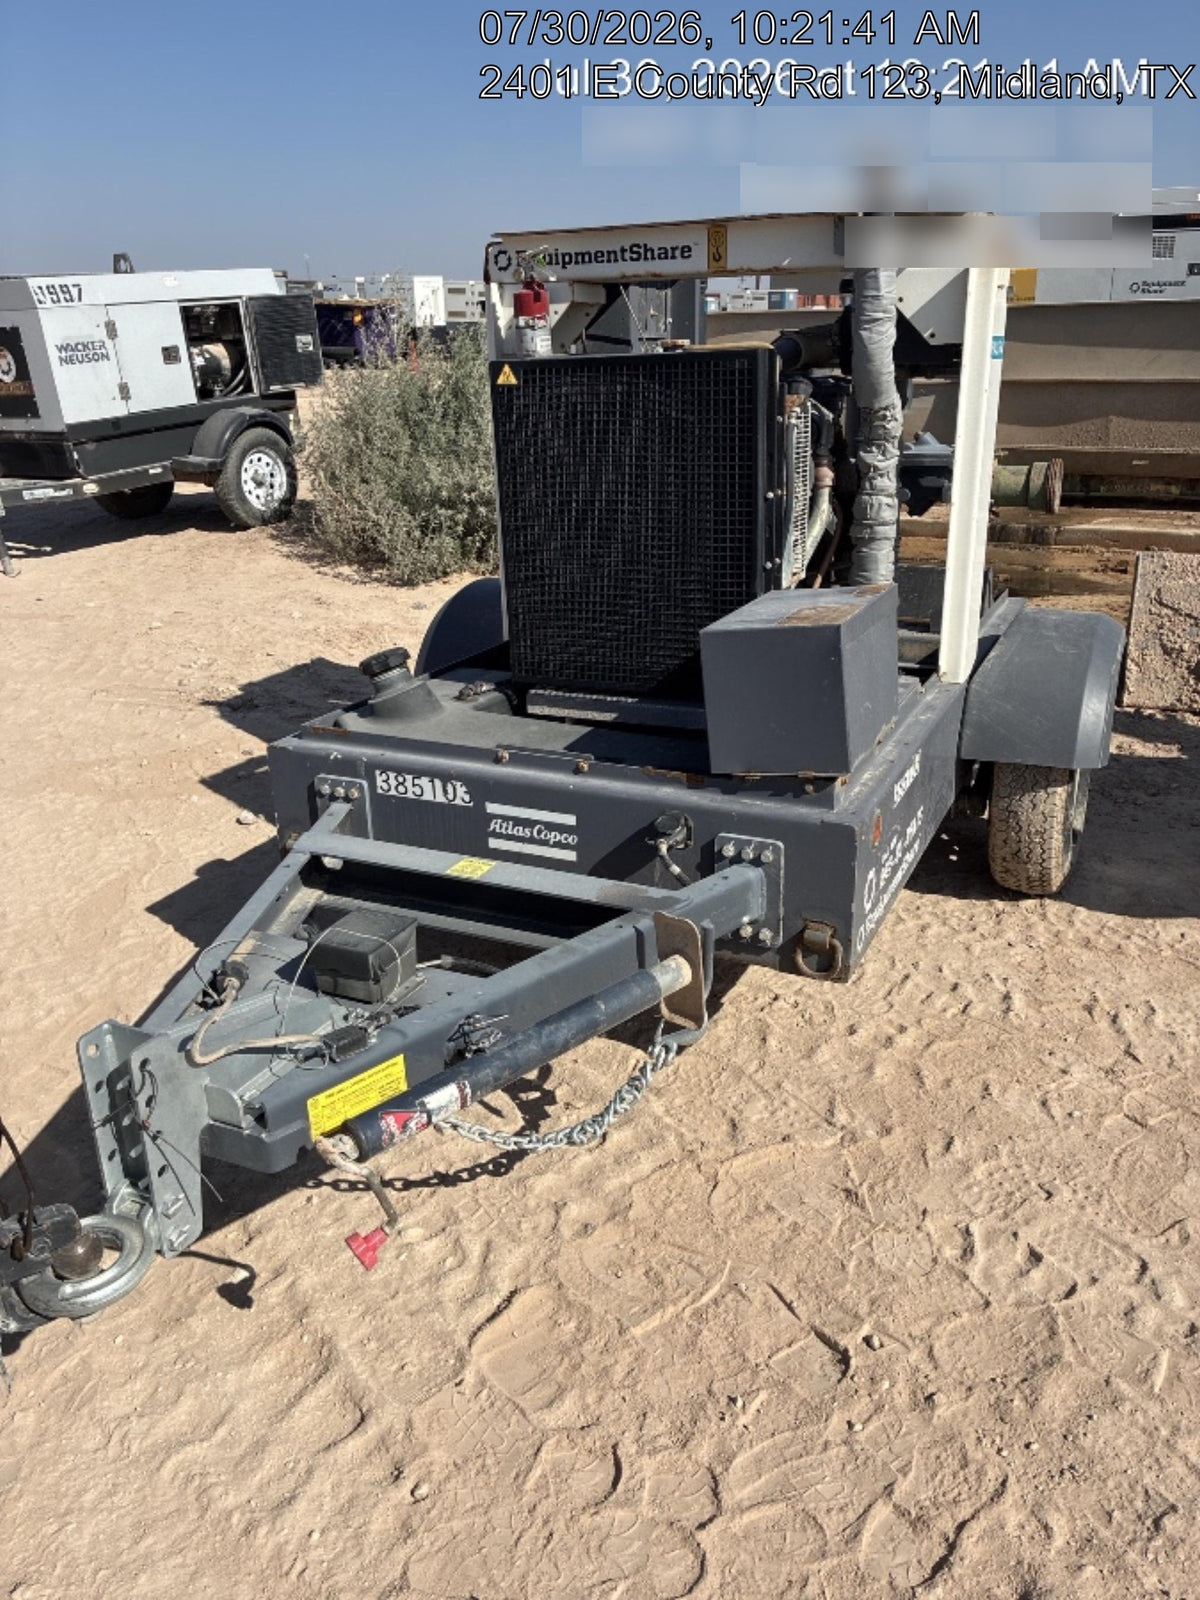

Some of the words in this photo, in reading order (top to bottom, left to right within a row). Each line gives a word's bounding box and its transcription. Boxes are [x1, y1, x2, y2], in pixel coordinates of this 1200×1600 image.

[516, 243, 692, 269] EuipmentShare
[54, 340, 108, 355] WACKER
[57, 351, 111, 367] NEUSON
[487, 818, 532, 838] Atlas
[533, 824, 578, 845] Copco
